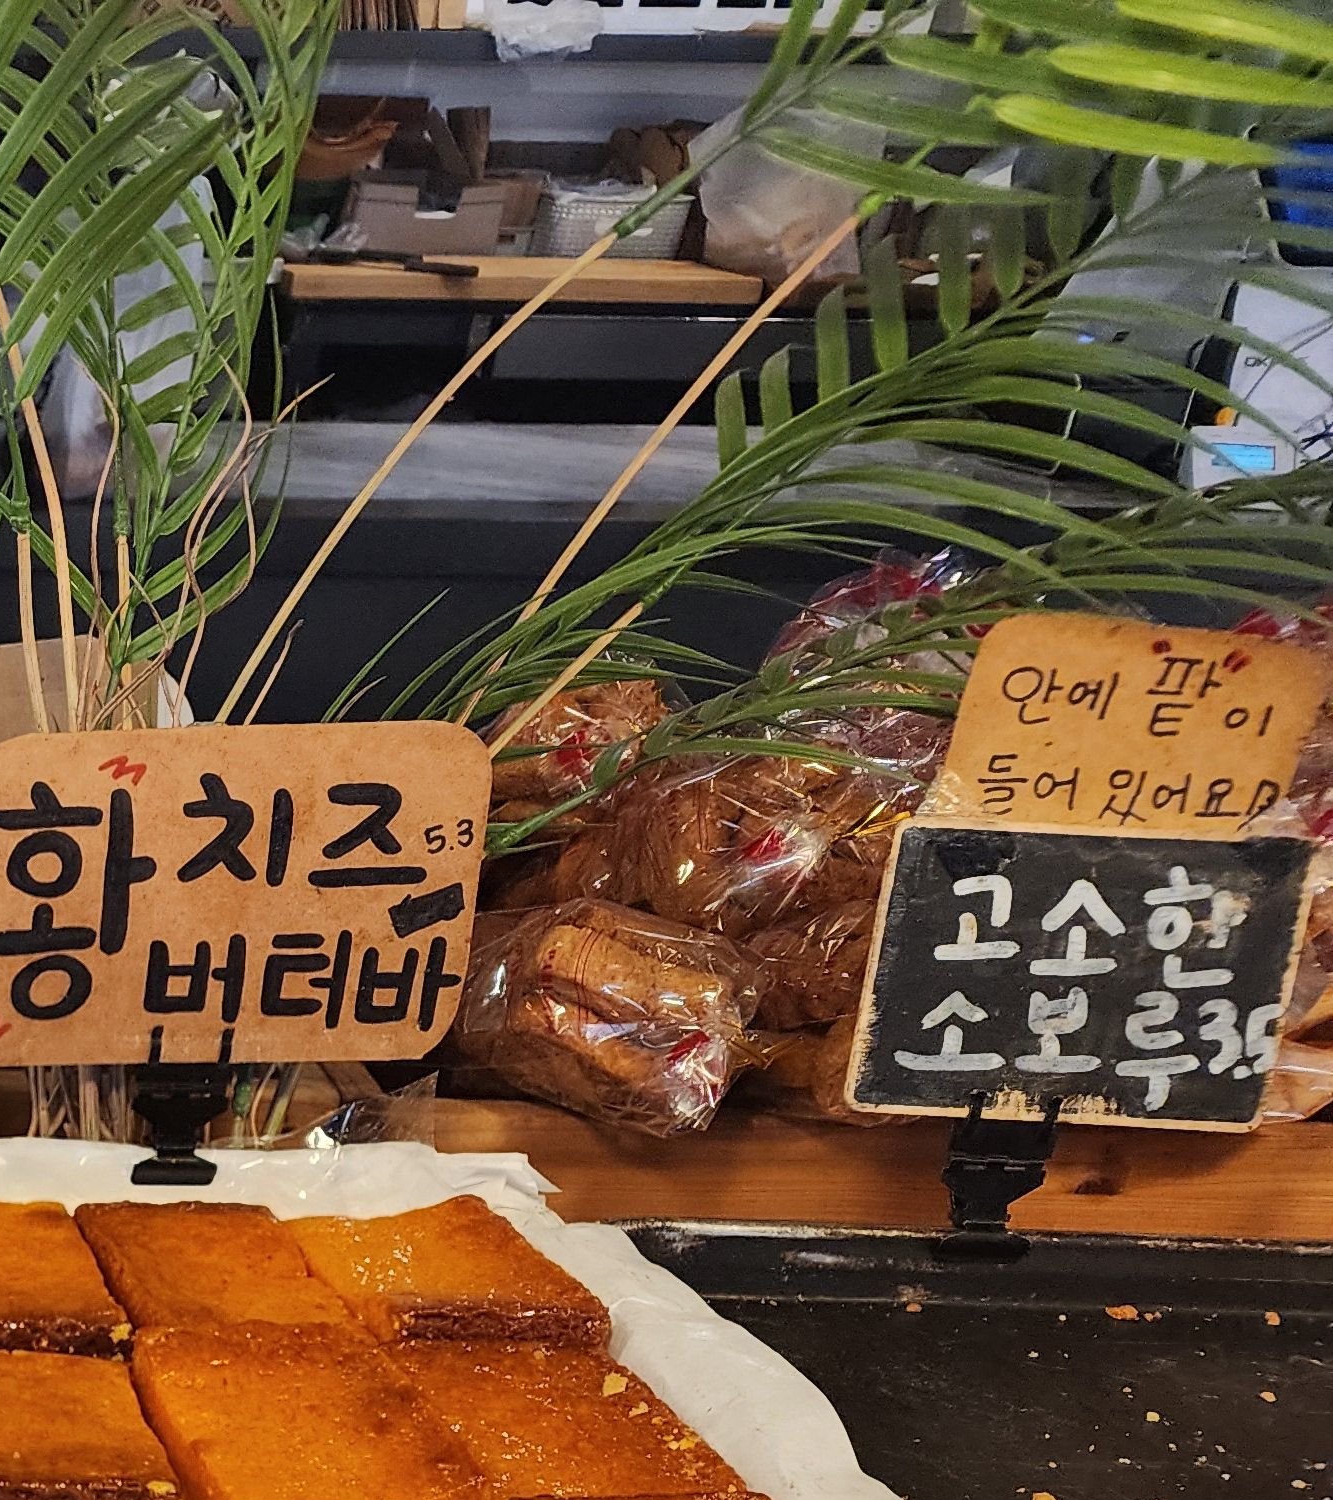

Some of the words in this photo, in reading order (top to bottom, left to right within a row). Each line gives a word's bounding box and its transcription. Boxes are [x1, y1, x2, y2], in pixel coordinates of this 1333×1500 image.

[1002, 666, 1120, 725] 안에
[977, 753, 1081, 817] 들어
[423, 818, 476, 855] 5.3
[933, 865, 1250, 989] 고소한
[142, 929, 463, 1032] 버터바
[892, 985, 1201, 1112] 소보루
